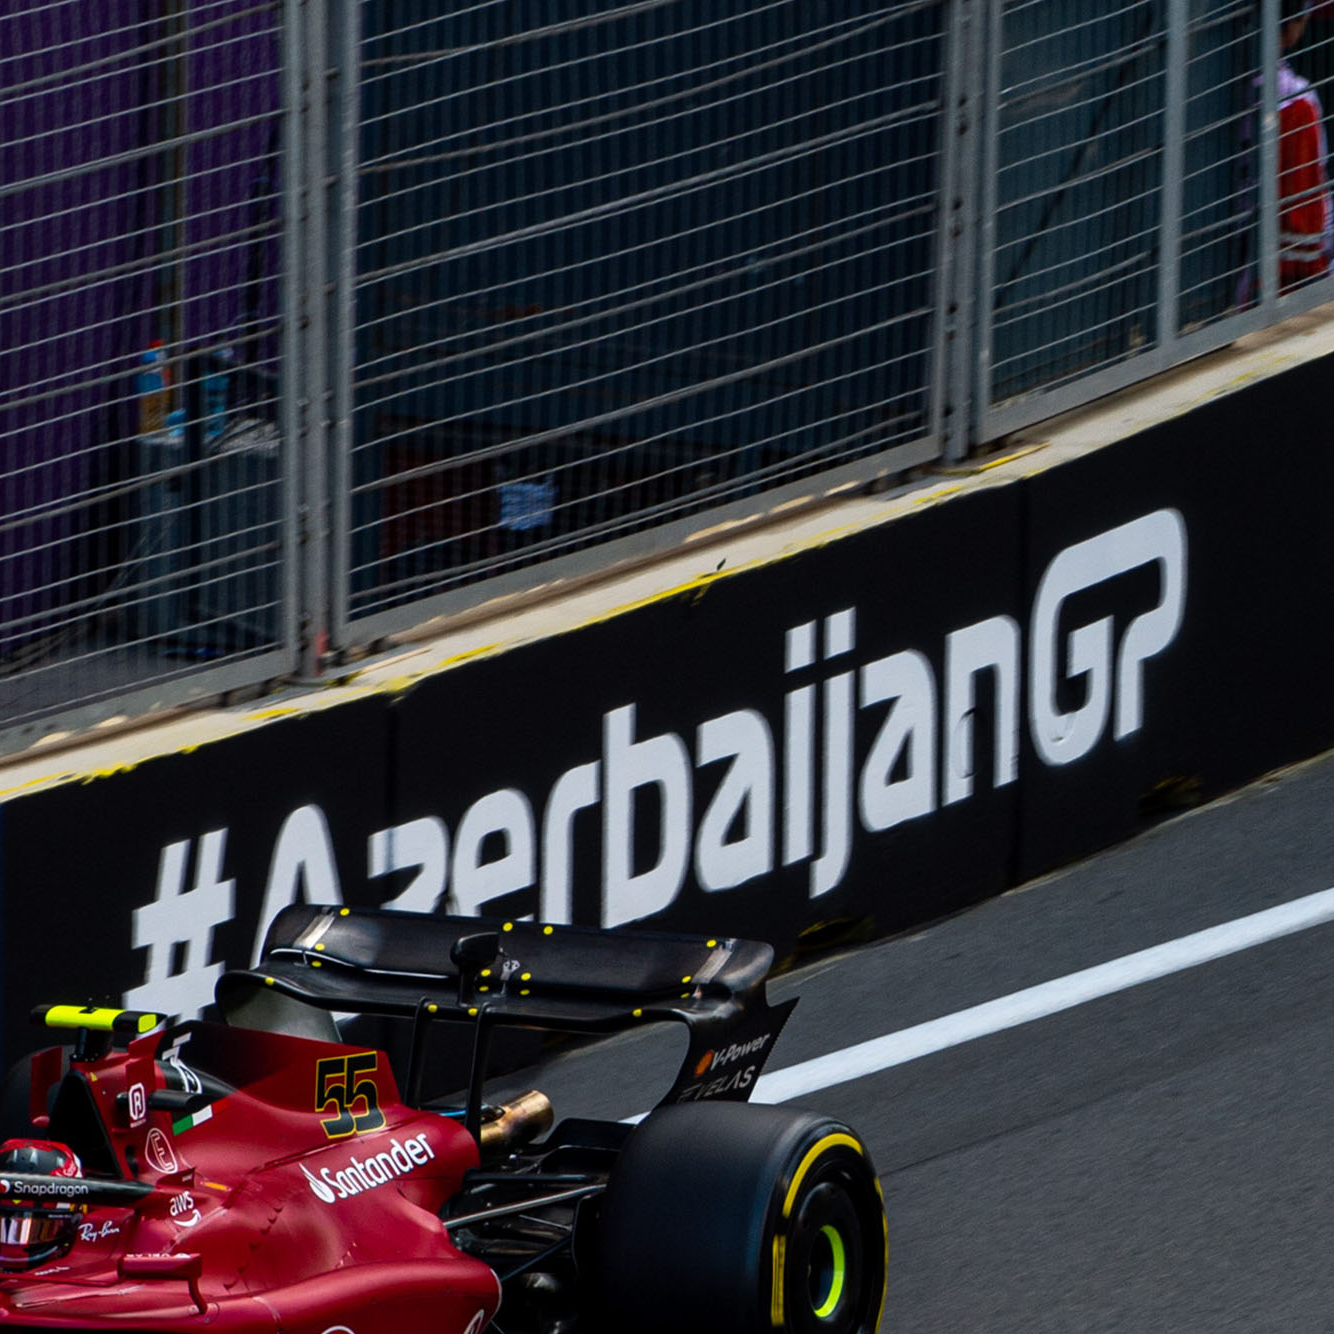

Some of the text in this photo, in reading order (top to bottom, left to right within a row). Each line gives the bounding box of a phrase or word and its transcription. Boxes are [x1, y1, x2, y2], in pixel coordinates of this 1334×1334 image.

[710, 1033, 770, 1071] V-Power
[315, 1050, 387, 1140] 55
[694, 1065, 755, 1101] VELAS
[320, 1133, 435, 1199] Santander
[14, 1181, 89, 1198] Snapdragon
[170, 1191, 194, 1217] aws
[78, 1221, 120, 1242] Ray-Ban
